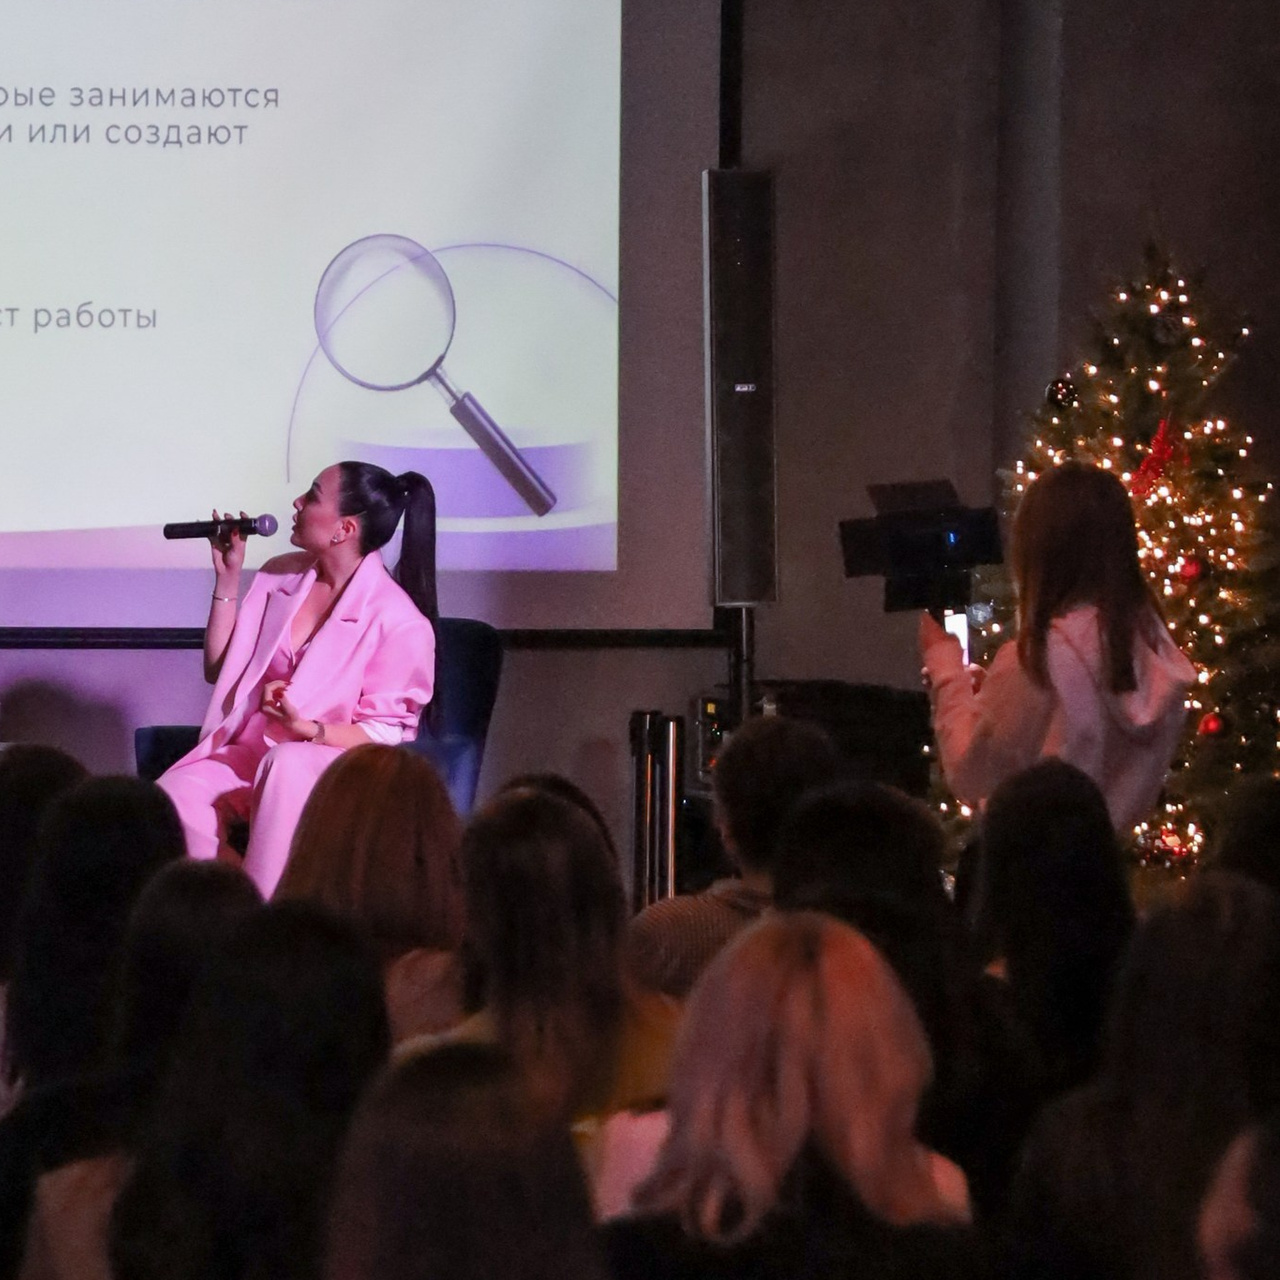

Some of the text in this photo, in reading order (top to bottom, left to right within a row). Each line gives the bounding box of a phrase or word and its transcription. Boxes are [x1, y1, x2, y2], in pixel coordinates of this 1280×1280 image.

[69, 86, 280, 110] занимаются
[27, 122, 91, 145] или
[104, 123, 249, 149] создают
[33, 300, 158, 335] работы
